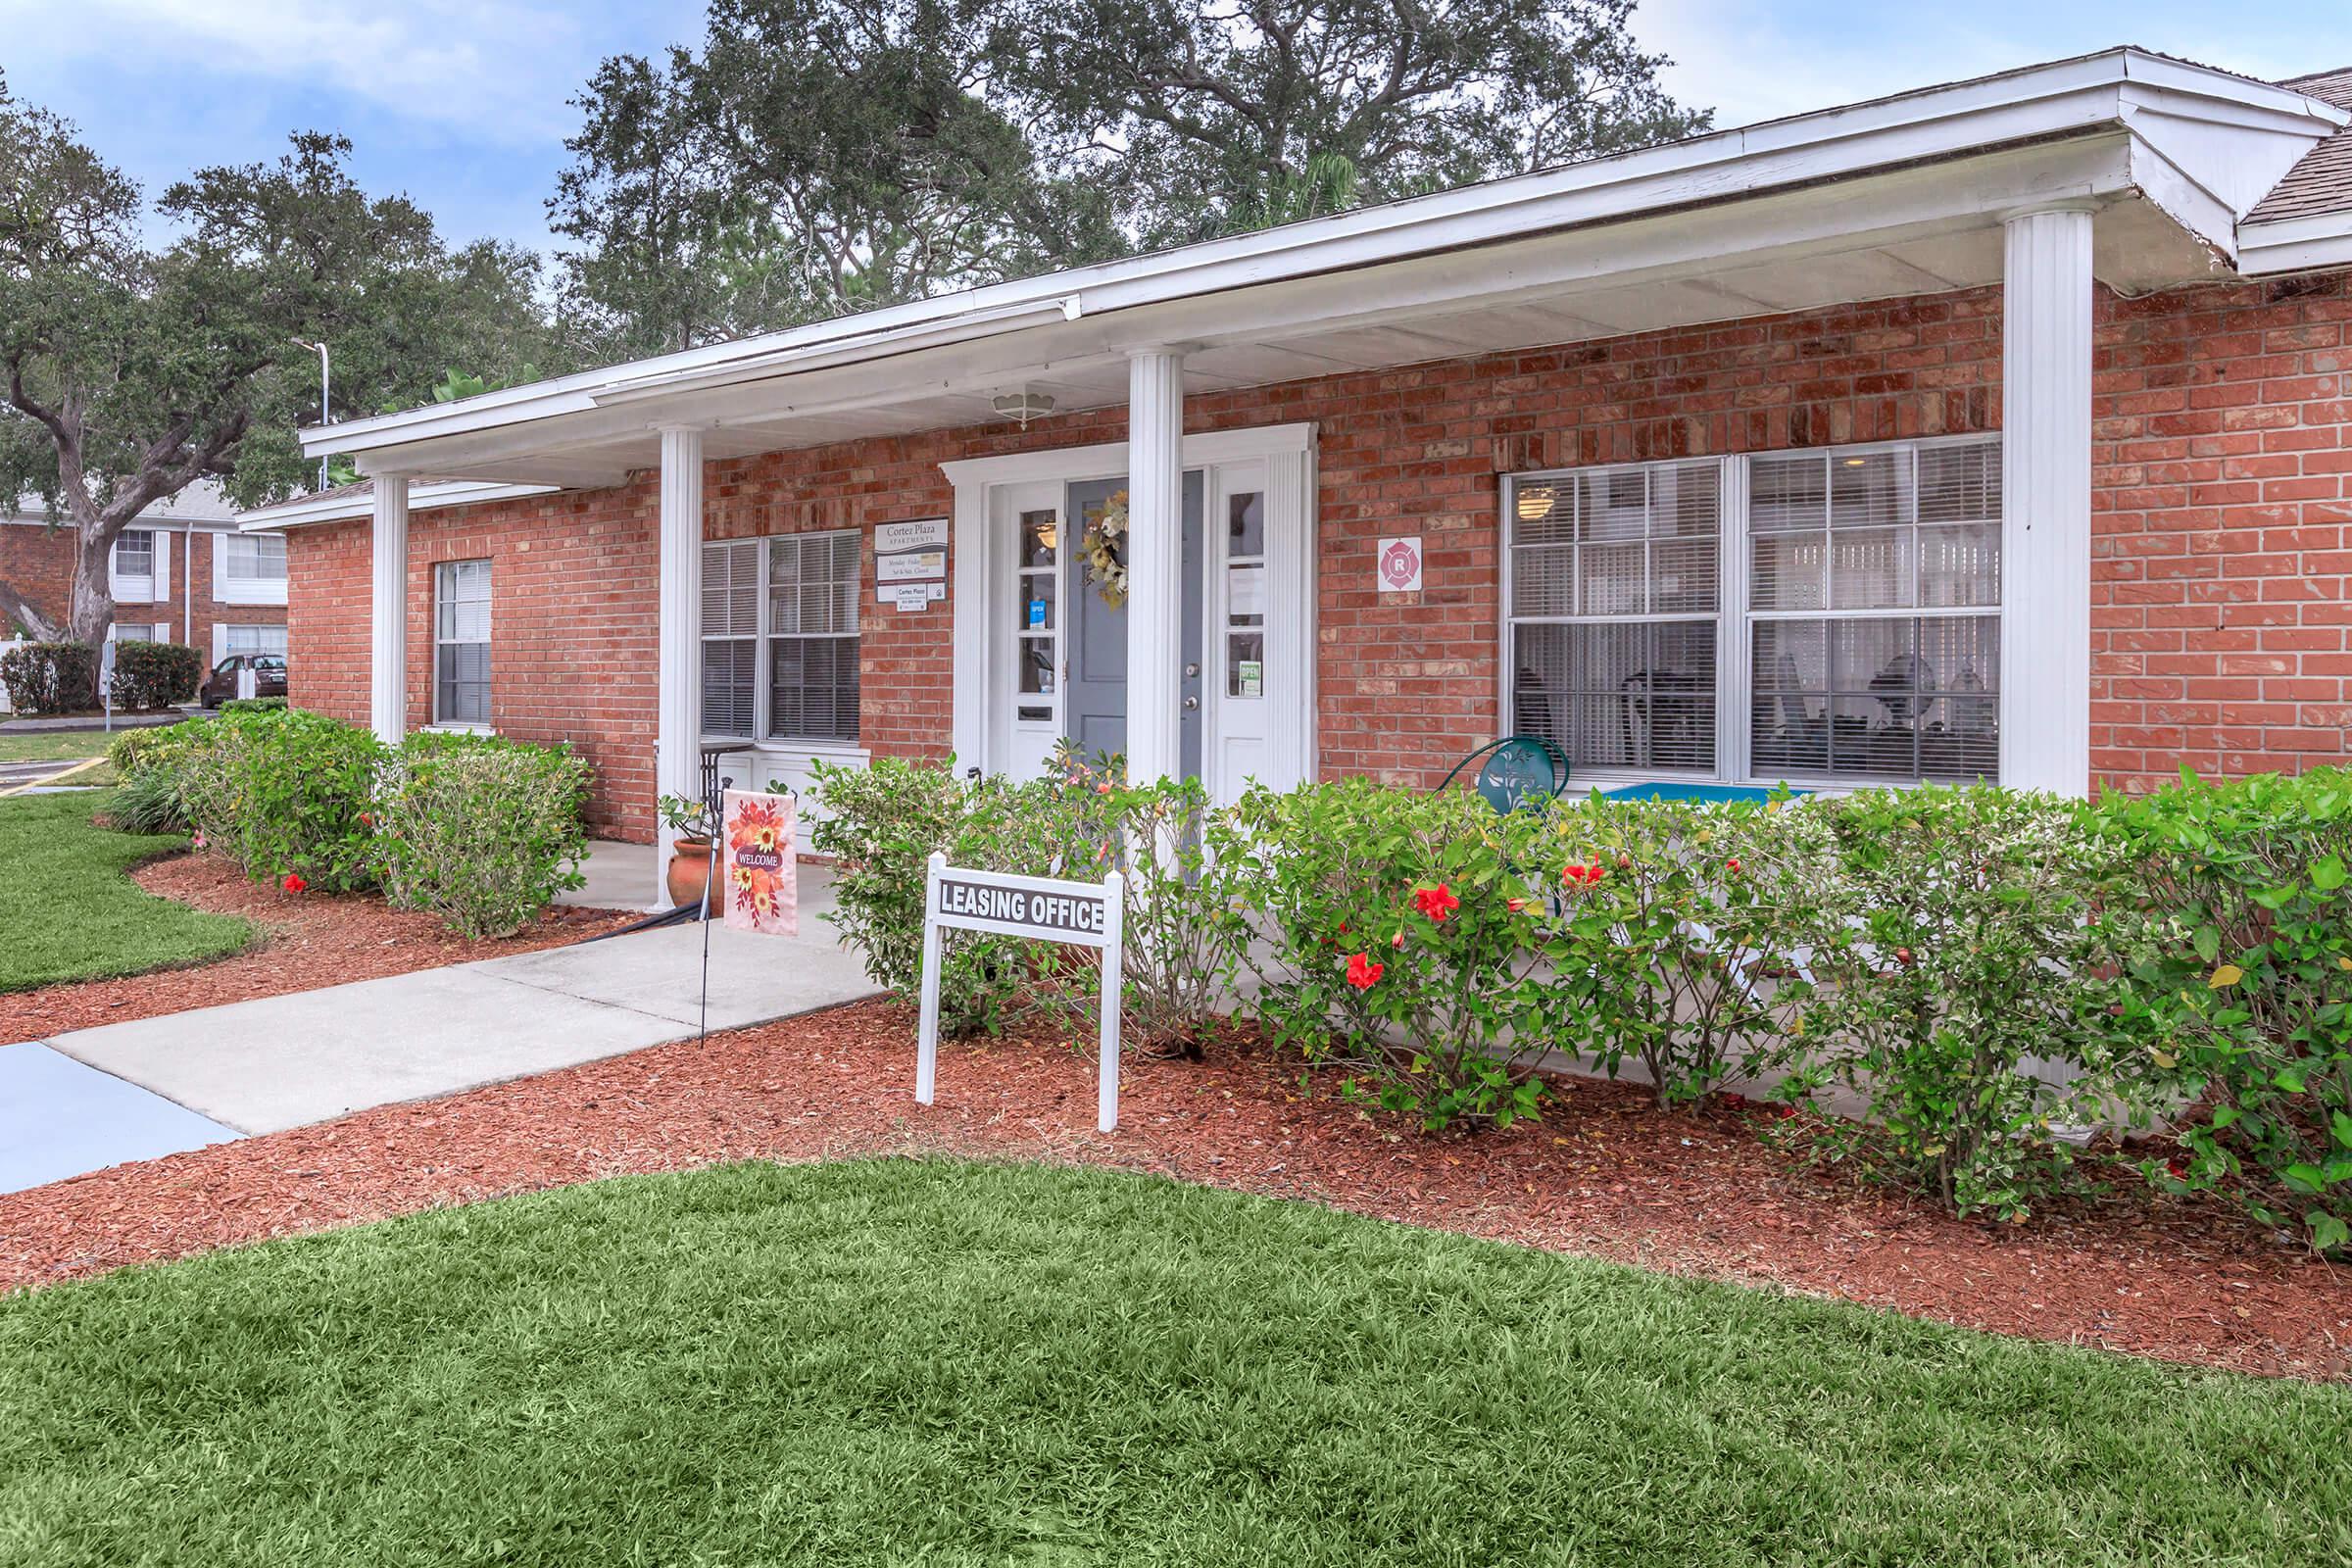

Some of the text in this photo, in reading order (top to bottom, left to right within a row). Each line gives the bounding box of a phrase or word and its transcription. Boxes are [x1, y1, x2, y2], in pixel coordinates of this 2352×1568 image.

[887, 523, 935, 536] Cortez Plaza
[1395, 559, 1405, 571] R
[1241, 666, 1258, 677] OPEN
[739, 853, 778, 867] WELCOME
[941, 883, 1104, 931] LEASING OFFICE
